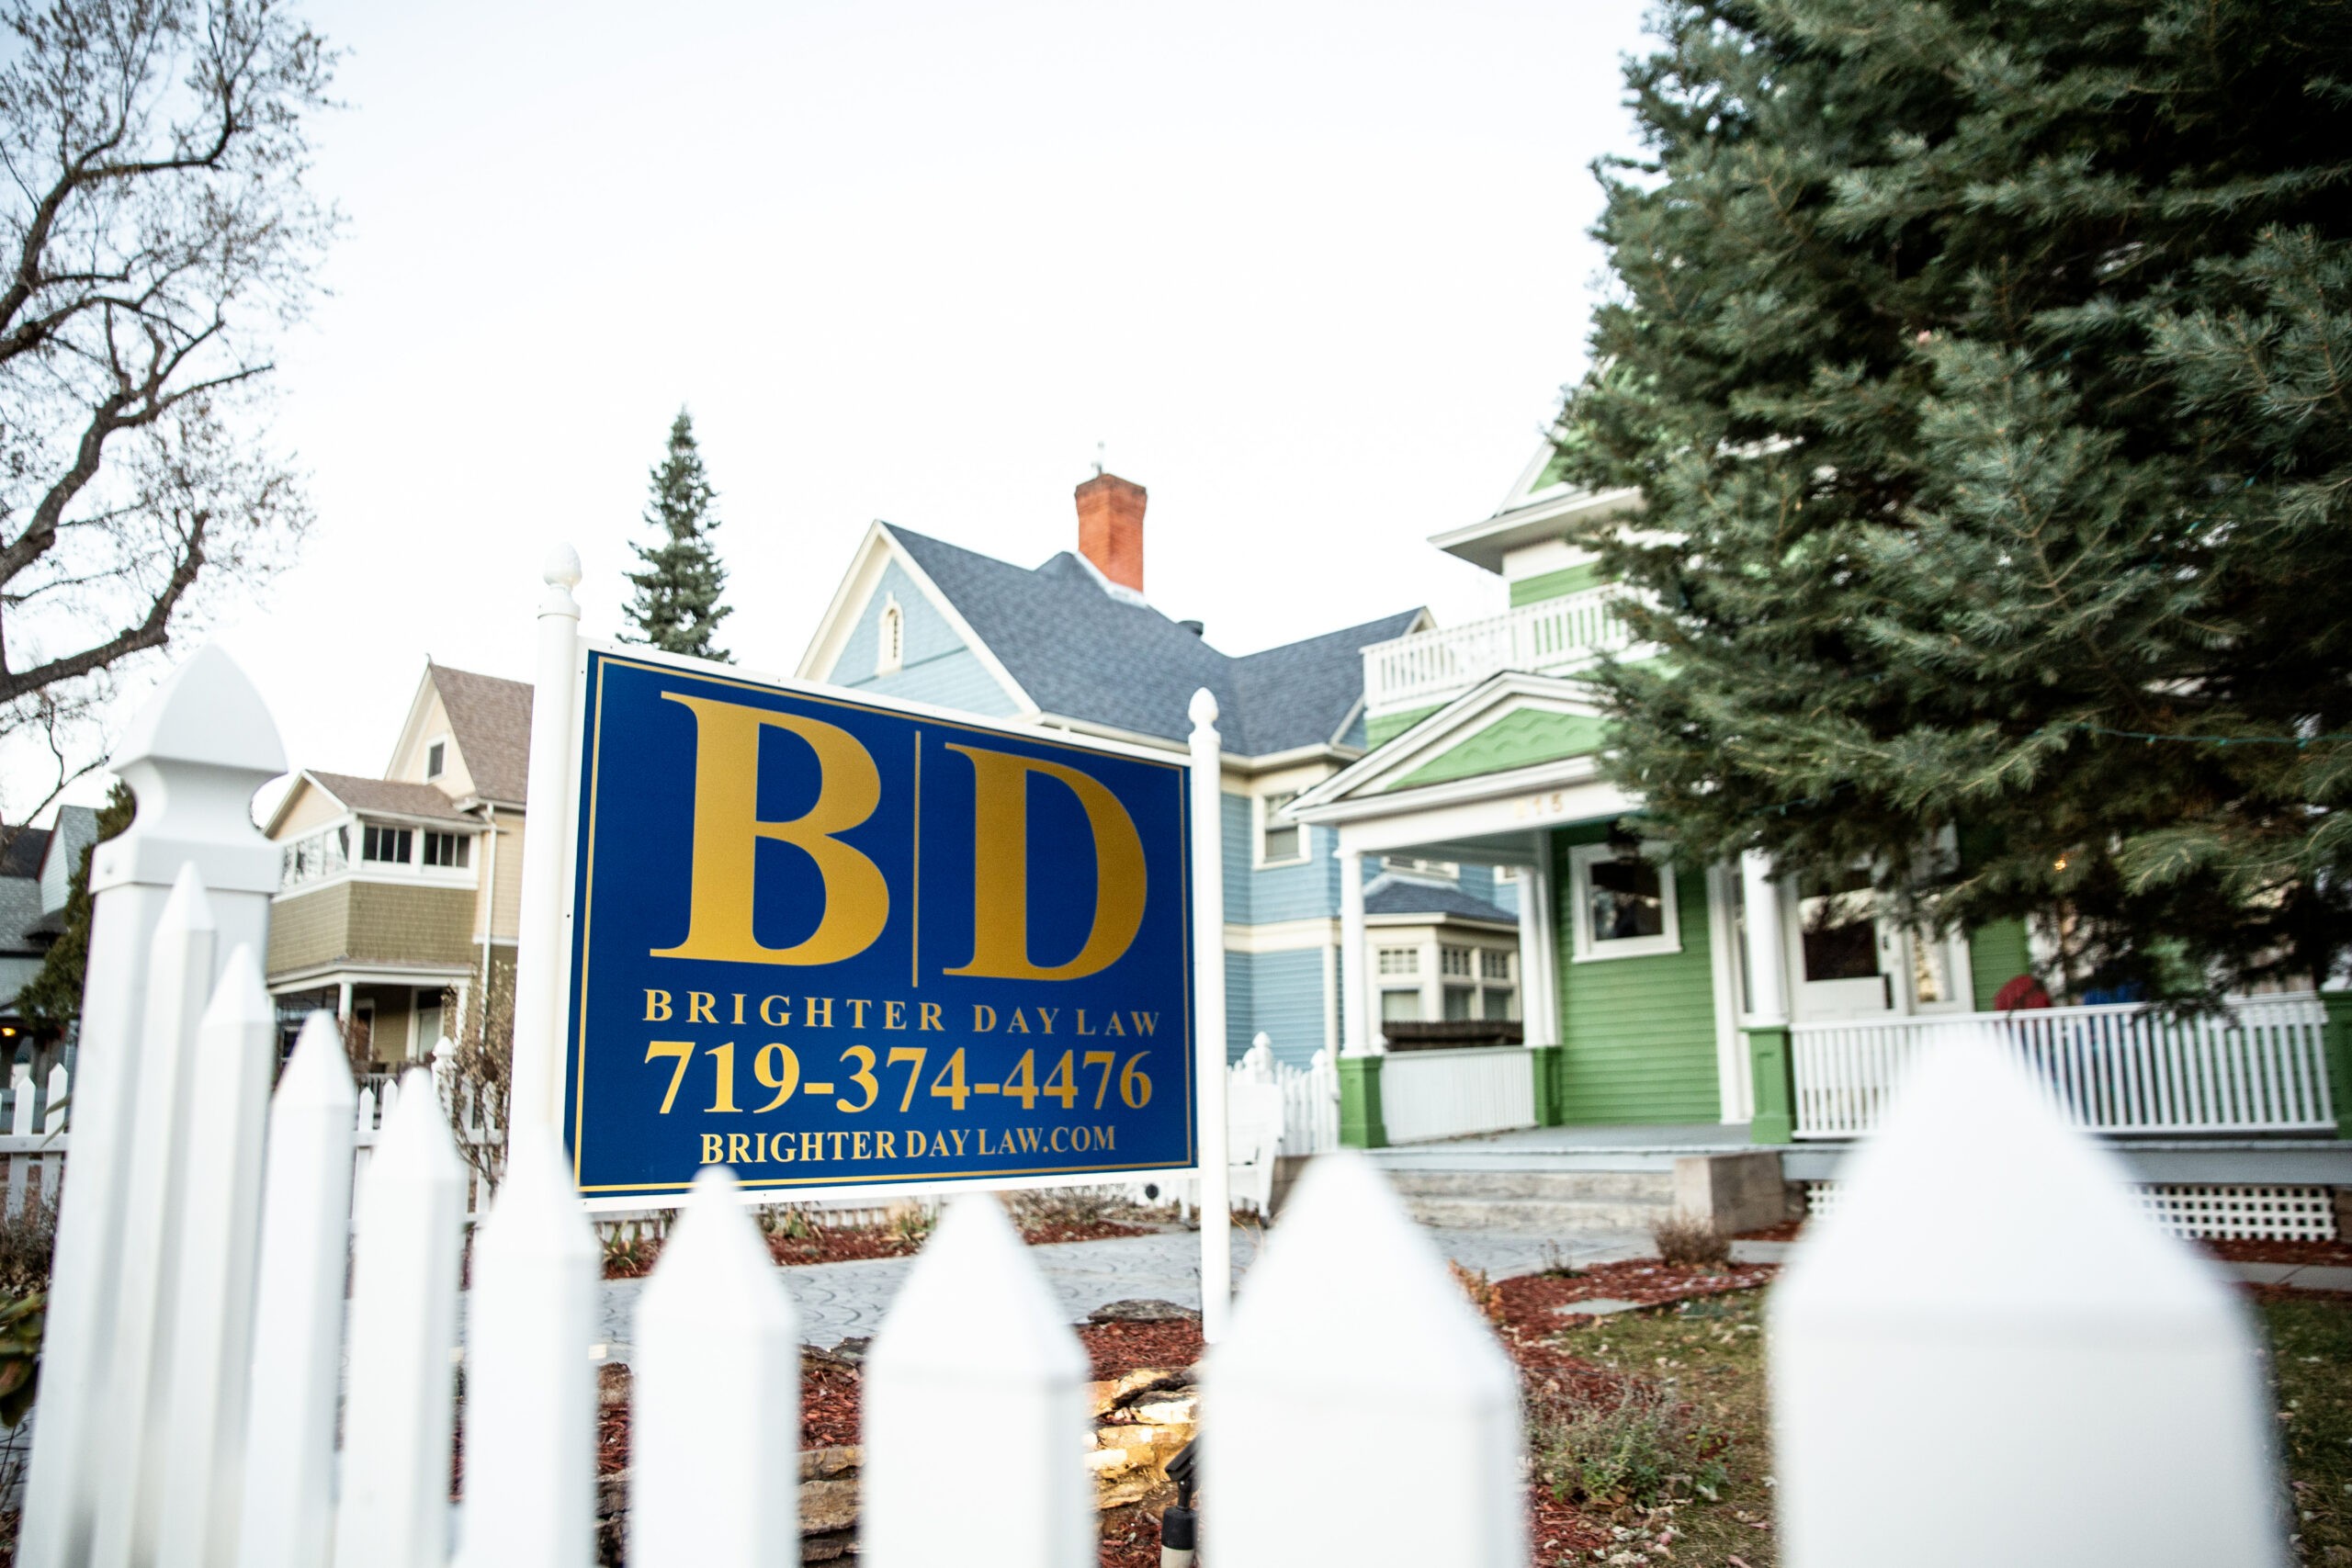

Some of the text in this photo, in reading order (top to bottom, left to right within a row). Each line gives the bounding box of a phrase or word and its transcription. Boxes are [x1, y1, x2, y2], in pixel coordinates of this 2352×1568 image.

[641, 988, 1159, 1037] BRIGHTER DAY LAW
[644, 1041, 1154, 1114] 719-374-4476
